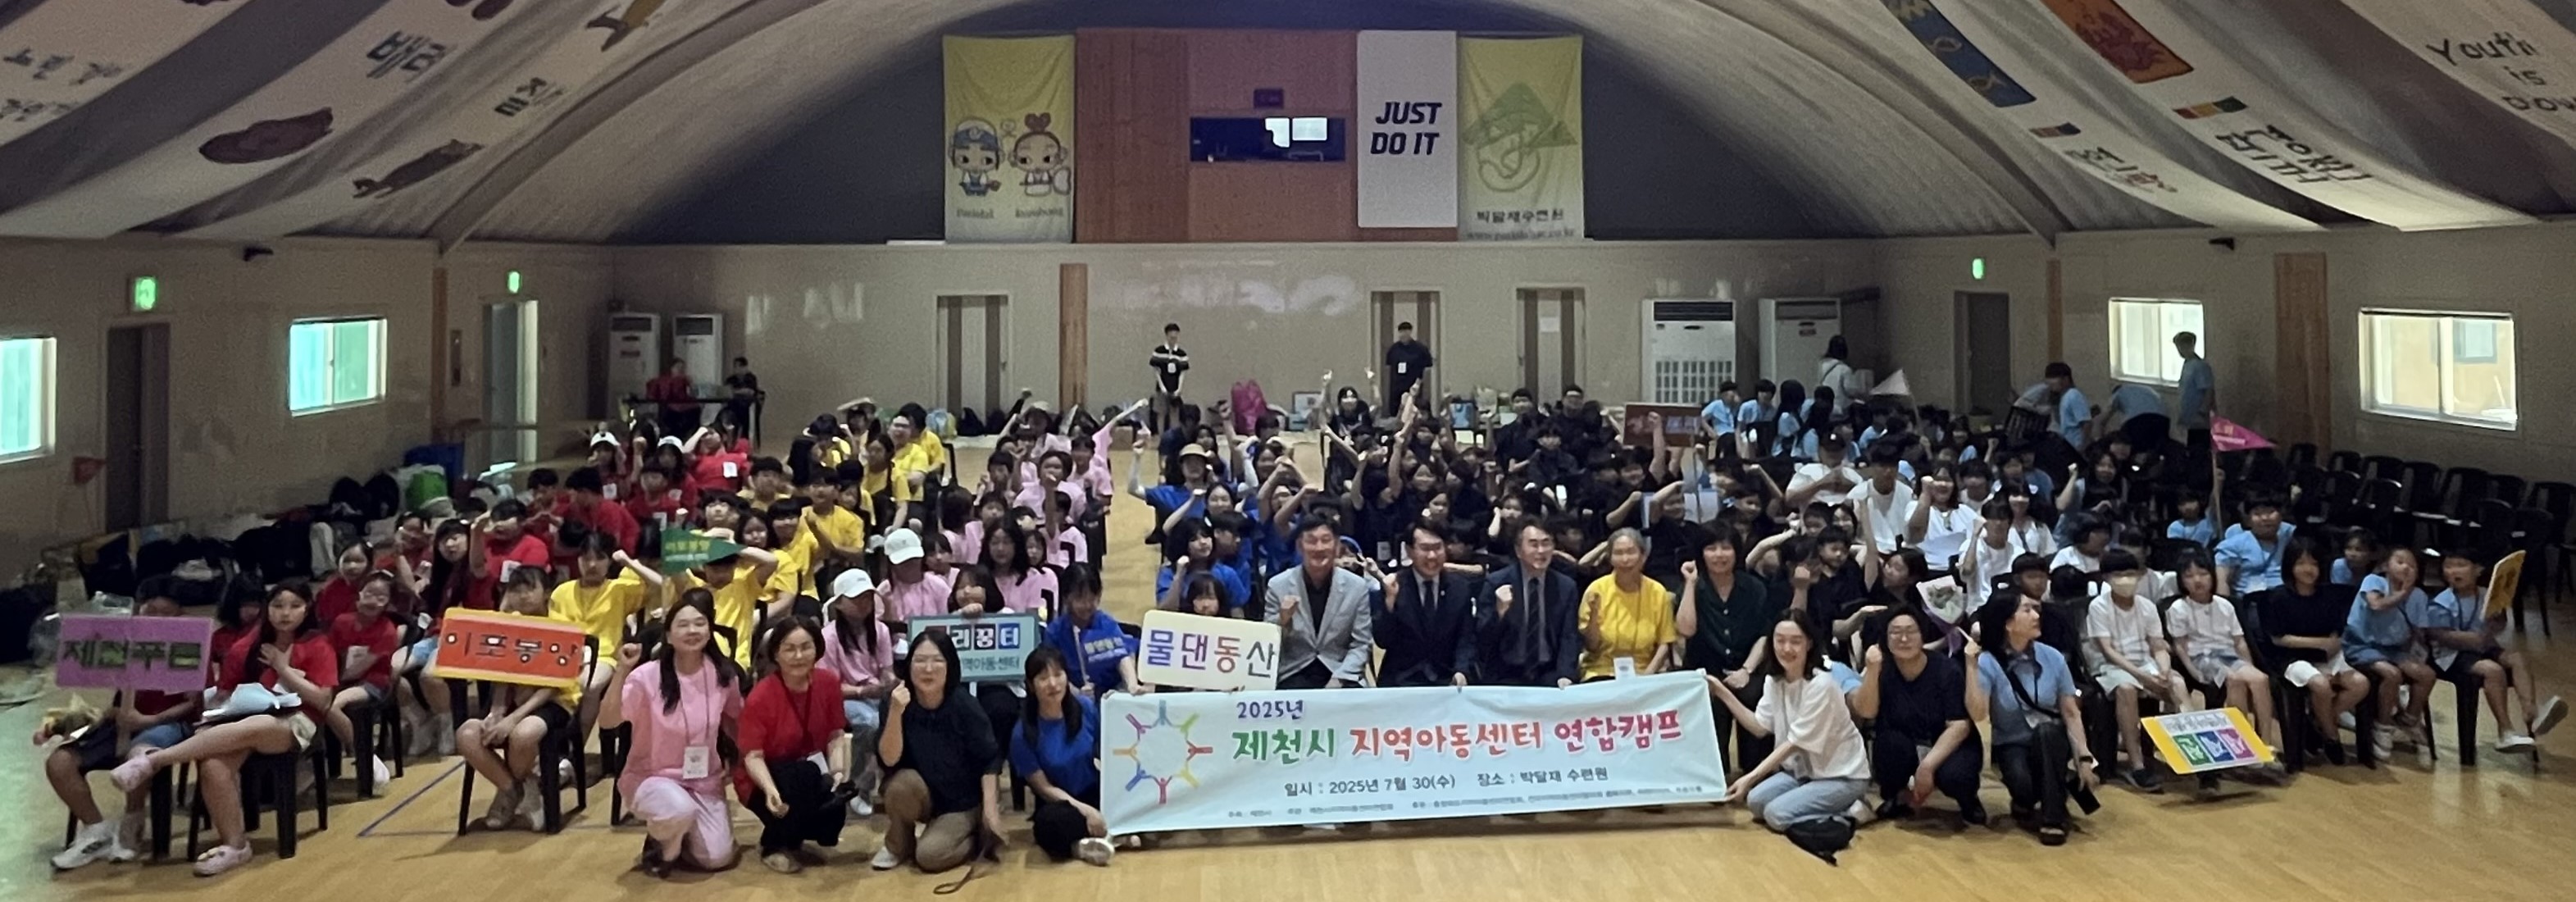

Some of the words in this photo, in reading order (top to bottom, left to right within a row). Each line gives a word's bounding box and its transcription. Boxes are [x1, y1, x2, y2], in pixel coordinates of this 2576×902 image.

[2425, 31, 2539, 66] Youth
[2503, 66, 2546, 85] is
[1375, 101, 1442, 125] JUST
[1370, 132, 1407, 155] DO
[1413, 132, 1440, 156] IT
[933, 626, 1020, 649] 리꿈터
[962, 655, 1021, 672] 역아동센터
[1146, 628, 1277, 679] 물댄동산
[1236, 699, 1304, 721] 2025년
[1231, 727, 1336, 764] 제천시
[1349, 721, 1542, 763] 지역아동센터
[1553, 708, 1682, 753] 연합캠프
[1284, 781, 1313, 797] 일시
[1328, 778, 1379, 795] 2025년
[1384, 777, 1407, 791] 7월
[1412, 774, 1456, 790] 30(수)
[1477, 771, 1505, 787] 장소
[1519, 770, 1562, 784] 박달재
[1566, 766, 1609, 782] 수련원
